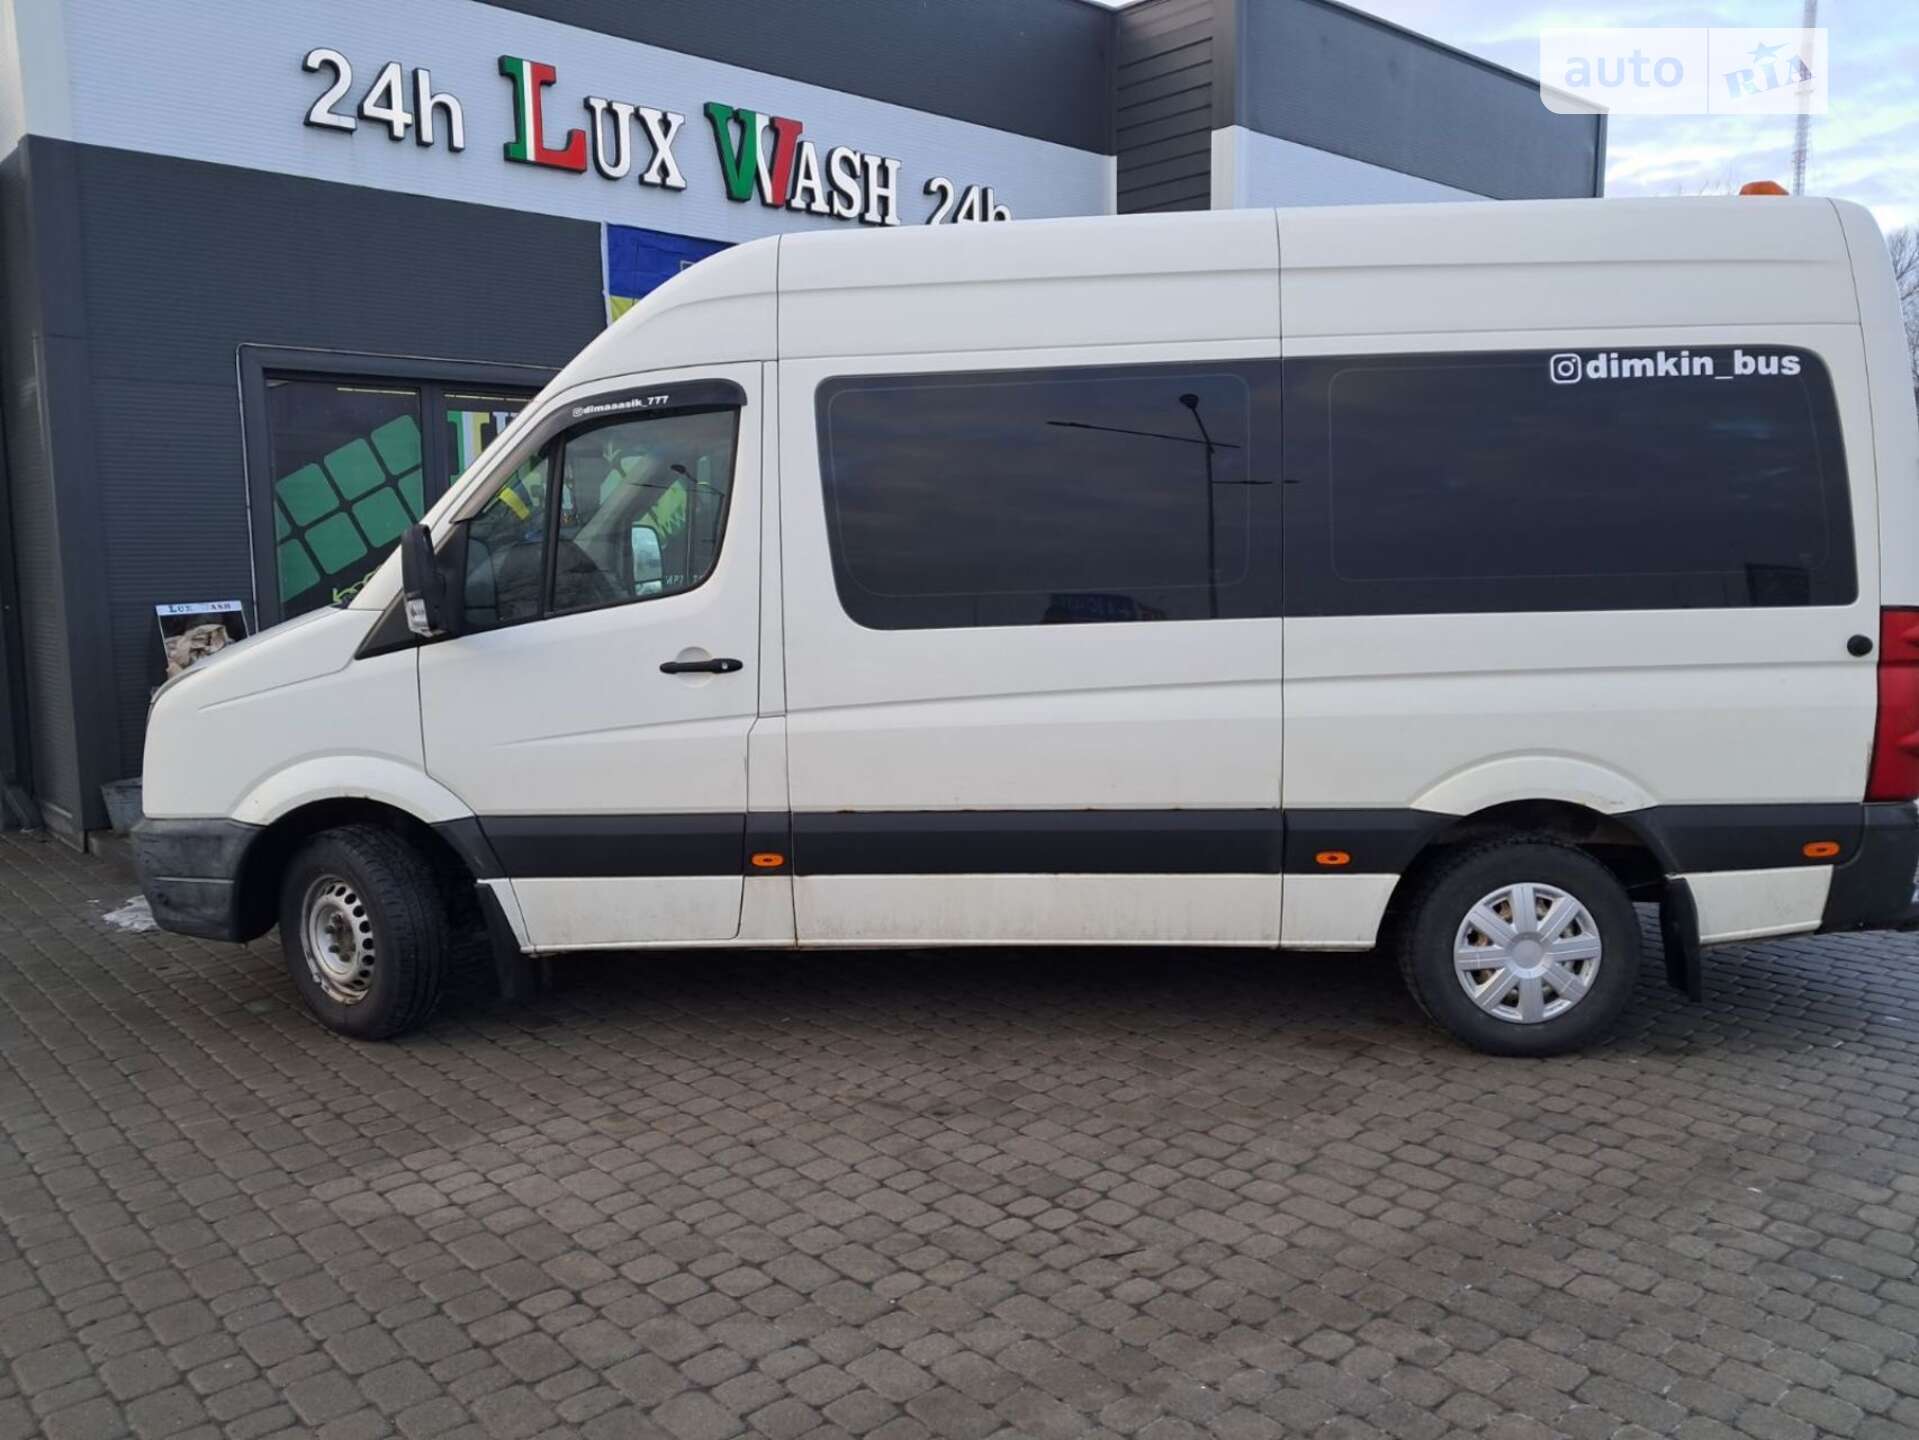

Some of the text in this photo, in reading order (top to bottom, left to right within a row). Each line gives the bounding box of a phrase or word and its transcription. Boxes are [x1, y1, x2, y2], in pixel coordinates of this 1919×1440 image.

[303, 47, 466, 154] 24h
[498, 54, 687, 191] LUX
[703, 101, 902, 226] WASH
[1585, 350, 1802, 380] dimkin_bus
